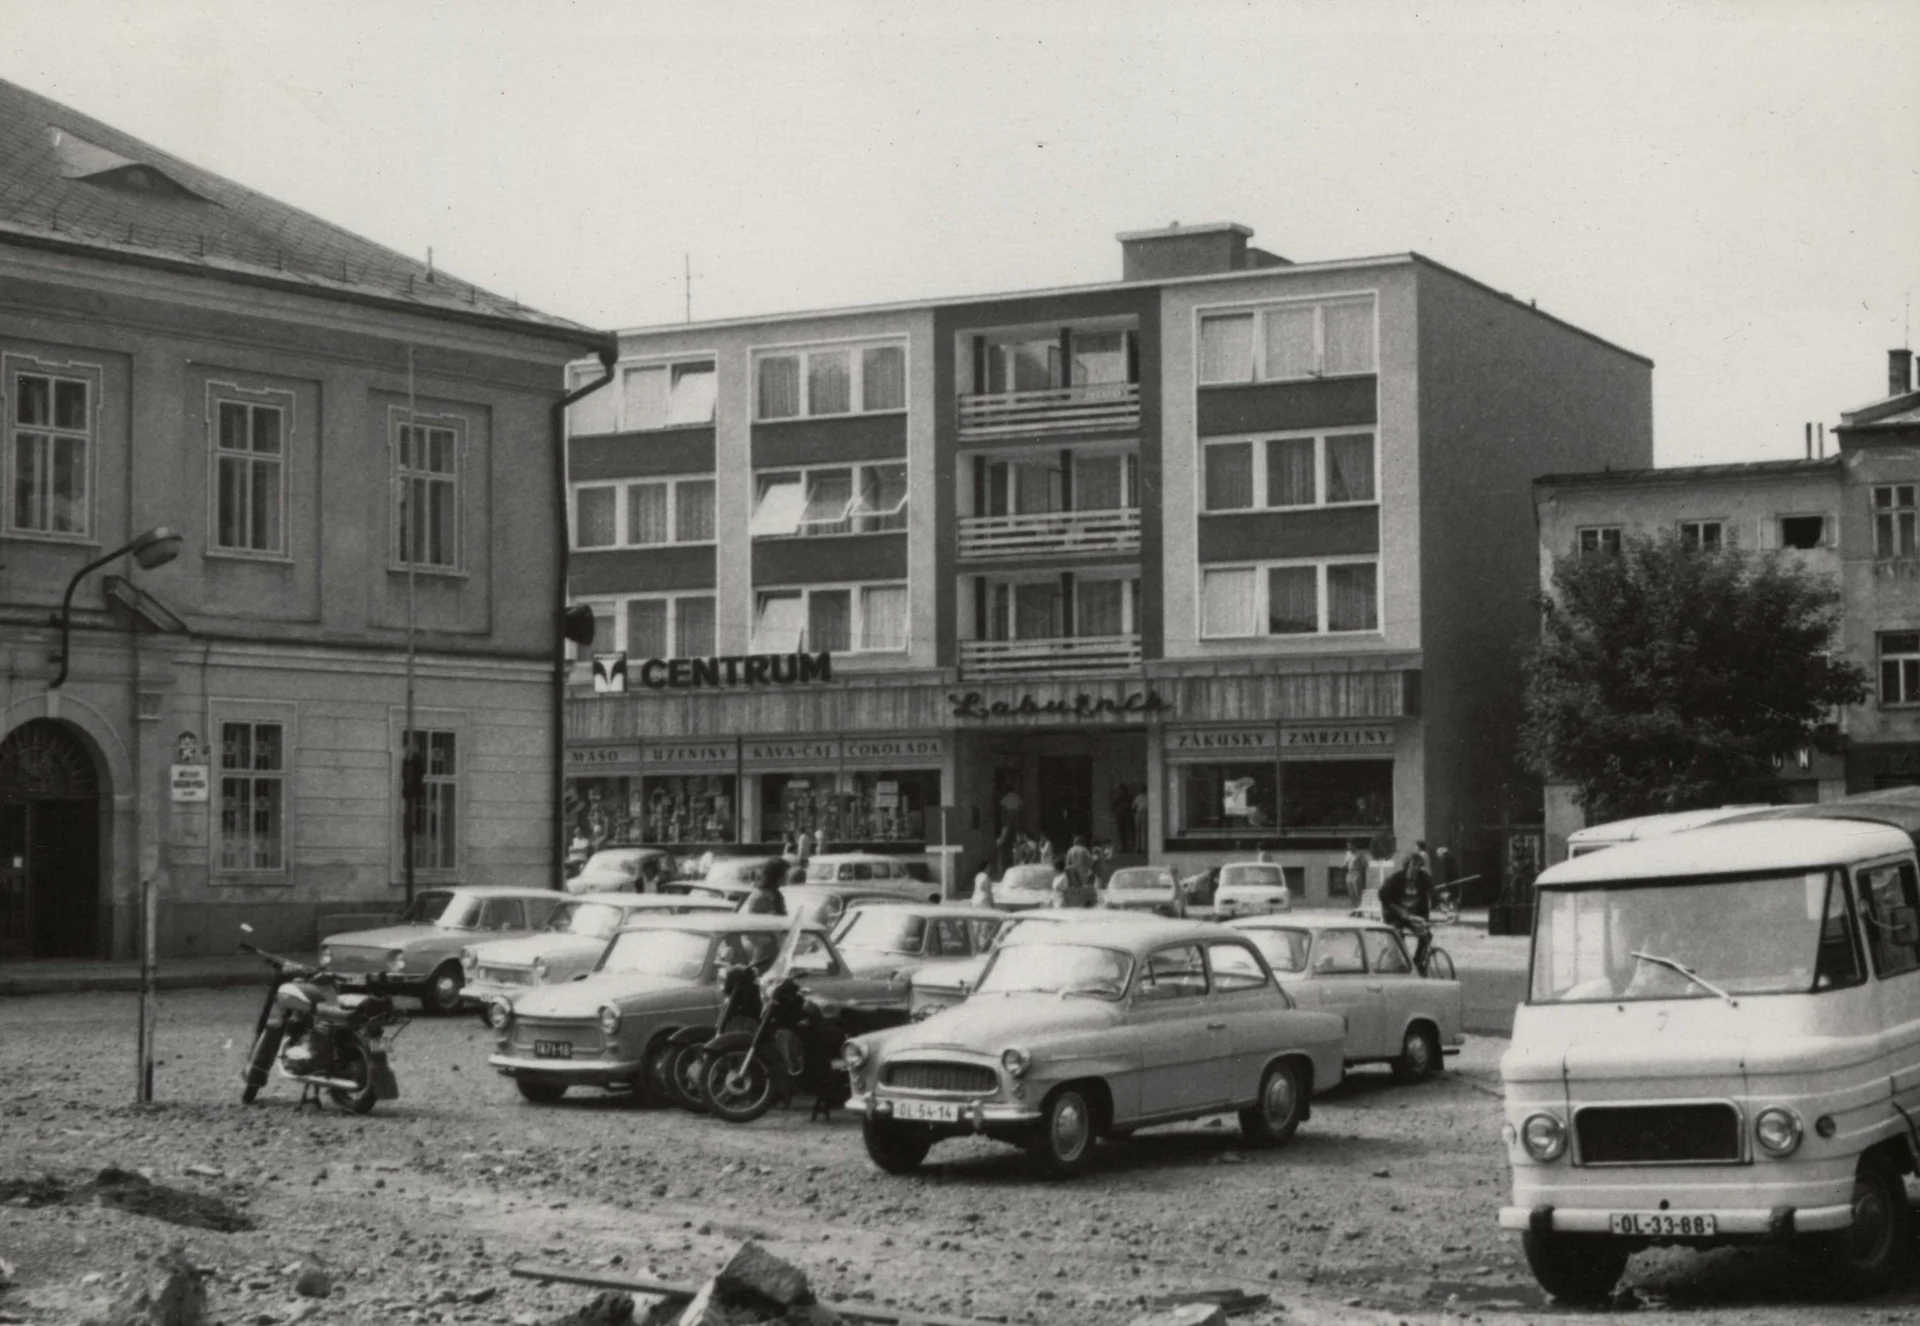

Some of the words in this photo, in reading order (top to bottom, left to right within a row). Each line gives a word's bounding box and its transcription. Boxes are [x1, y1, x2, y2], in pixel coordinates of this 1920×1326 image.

[640, 651, 832, 690] CENTRUM
[1288, 730, 1389, 745] ZMRZLINY
[571, 750, 620, 763] MASO
[652, 747, 728, 760] UZENINY
